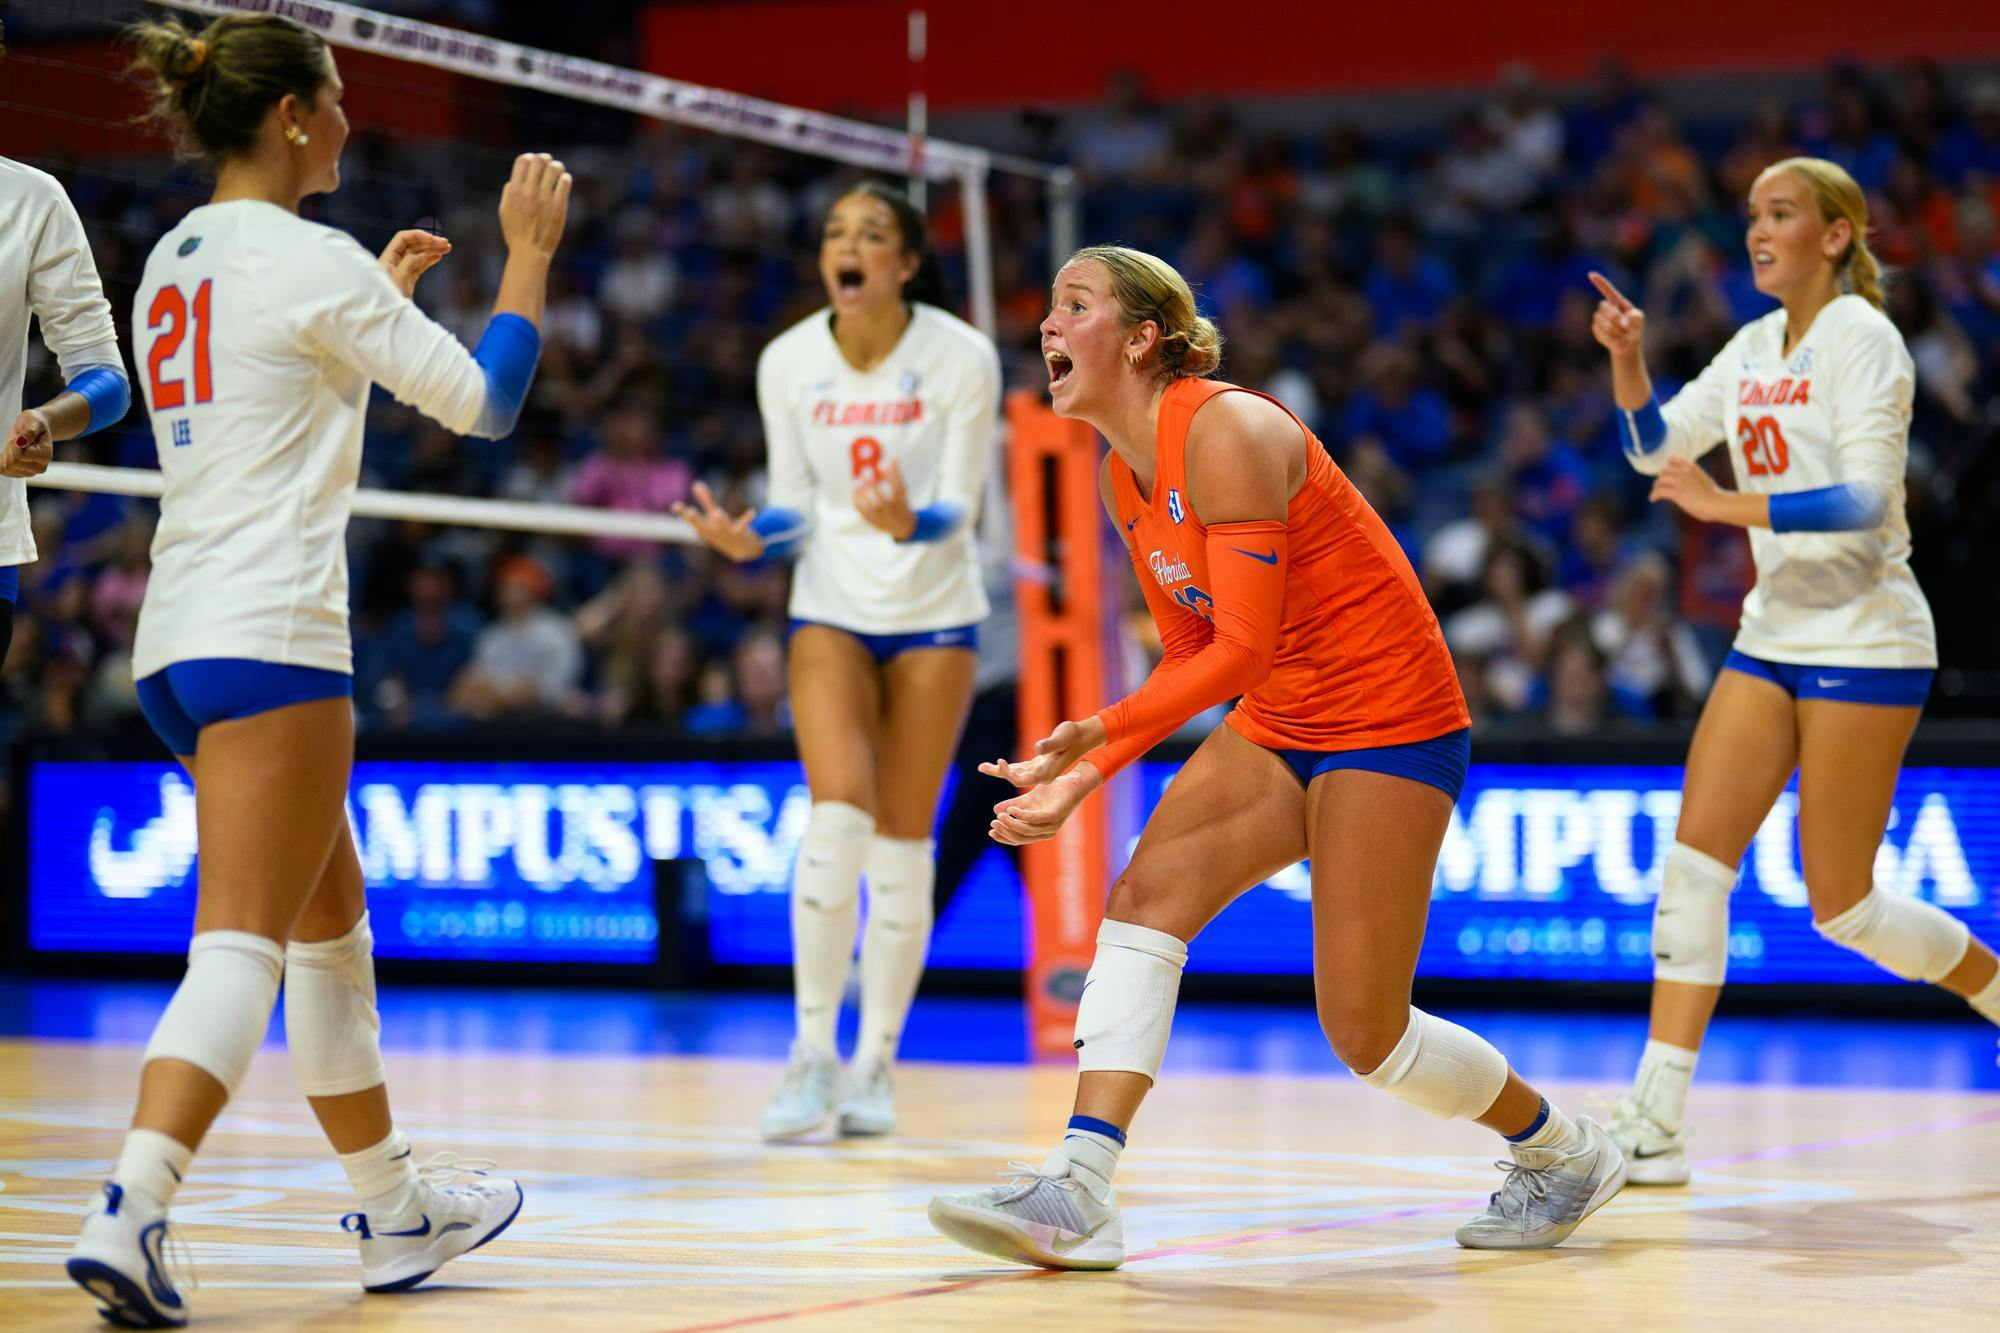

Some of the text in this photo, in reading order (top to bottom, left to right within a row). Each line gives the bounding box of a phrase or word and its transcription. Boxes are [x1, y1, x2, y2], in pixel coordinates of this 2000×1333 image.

[147, 278, 213, 412] 21
[171, 418, 192, 448] LEE
[812, 397, 923, 428] FLORIDA
[849, 436, 883, 483] 8
[1737, 415, 1790, 477] 20
[1149, 549, 1193, 587] Florida
[350, 783, 641, 892] MPUS
[1436, 788, 1683, 904] MPU
